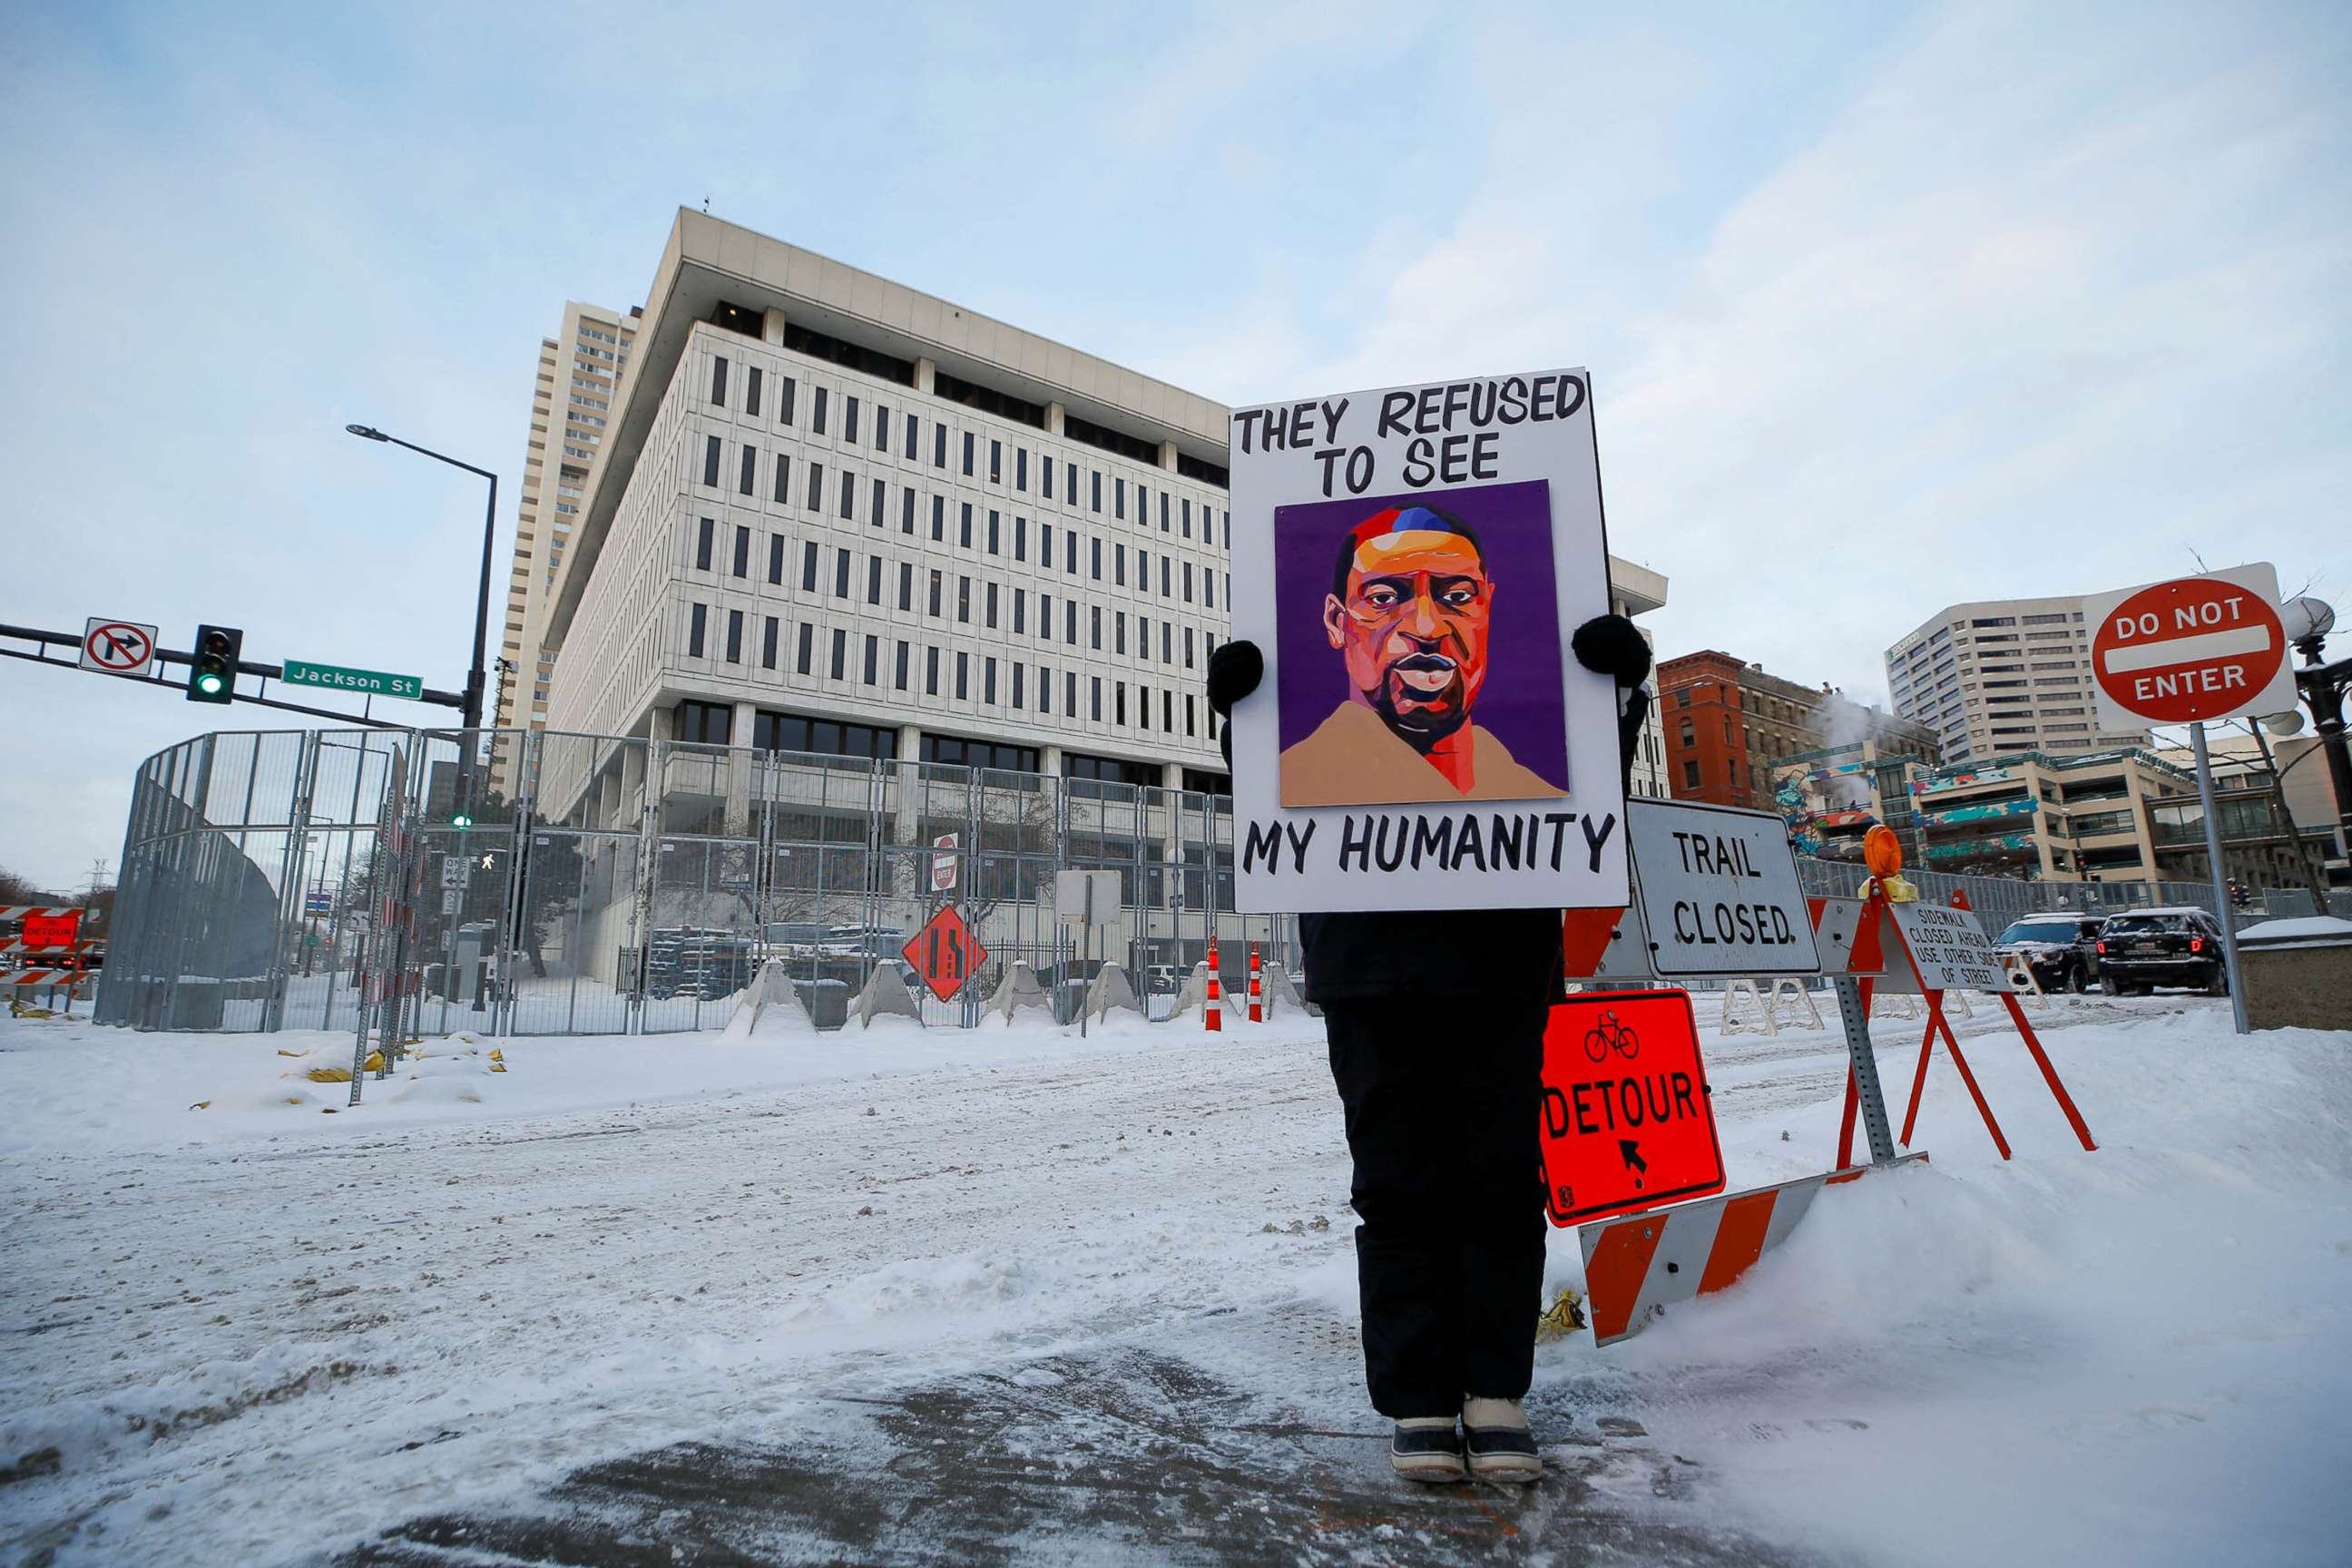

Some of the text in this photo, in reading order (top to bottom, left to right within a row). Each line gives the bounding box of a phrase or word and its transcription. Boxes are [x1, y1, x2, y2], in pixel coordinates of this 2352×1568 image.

[1234, 375, 1585, 454] THEY REFUSED
[1314, 432, 1499, 497] TO SEE
[2116, 596, 2243, 640] DO NOT
[293, 667, 414, 693] Jackson St
[2134, 664, 2246, 701] ENTER
[1242, 813, 1616, 875] MY HUMANITY
[1672, 831, 1762, 877] TRAIL
[26, 927, 73, 936] DETOUR
[1673, 900, 1790, 945] CLOSED
[1909, 927, 1987, 948] CLOSED AHEAD
[1917, 908, 1967, 927] SIDEWALK
[1915, 946, 1998, 967] USE OTHER SIDE
[1941, 967, 1995, 985] OF STREET
[1543, 1072, 1698, 1140] DETOUR
